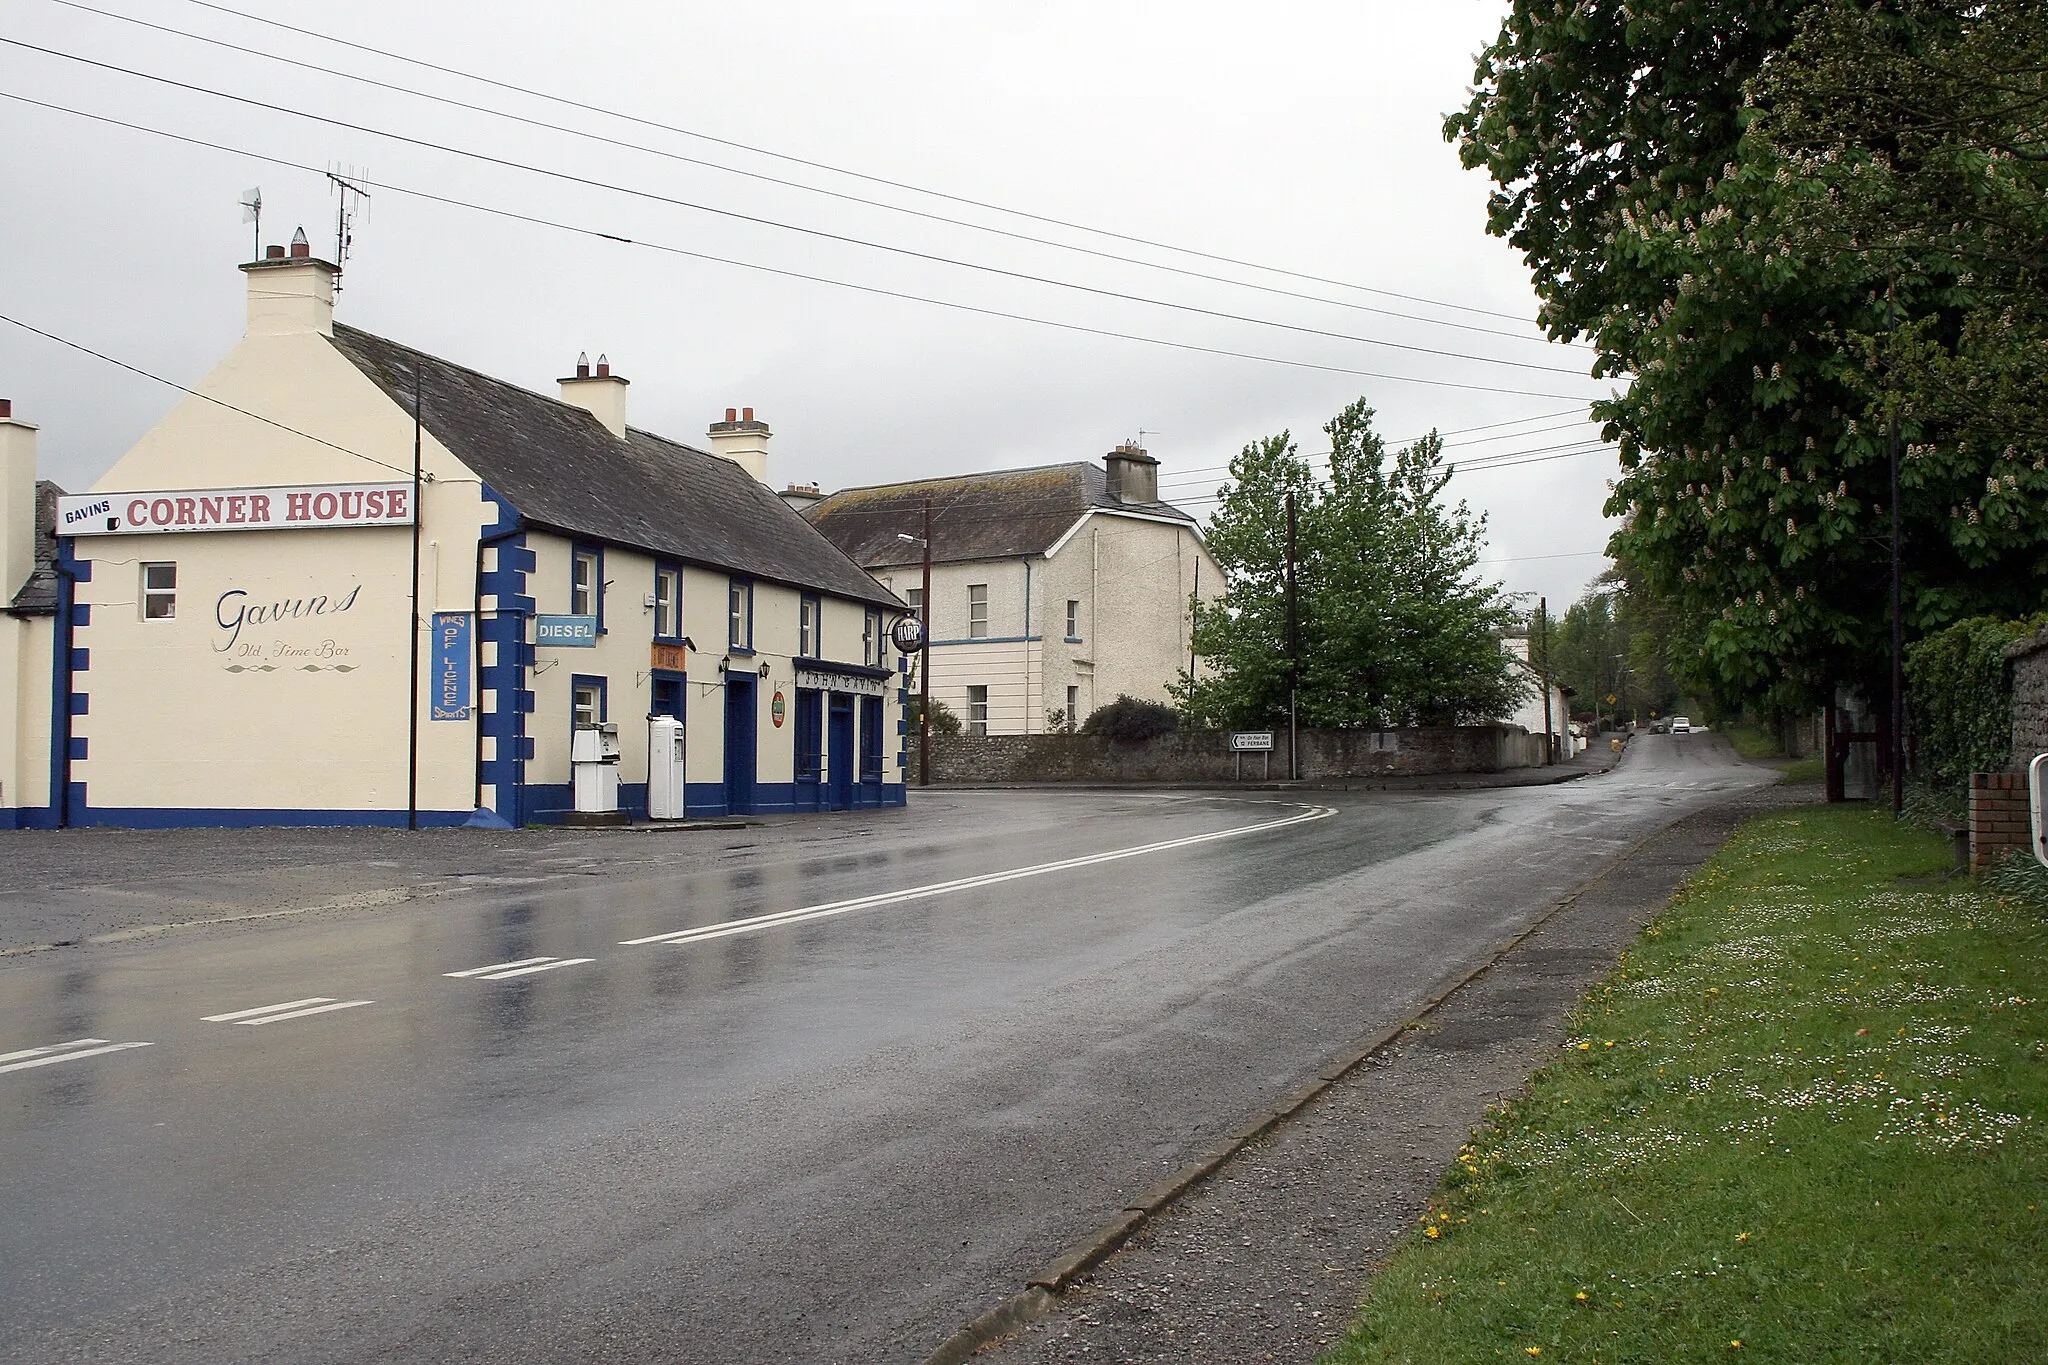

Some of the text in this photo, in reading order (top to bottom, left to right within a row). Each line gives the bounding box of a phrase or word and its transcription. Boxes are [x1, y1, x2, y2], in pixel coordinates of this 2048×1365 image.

[65, 500, 111, 524] GAVINS
[127, 490, 408, 526] CORNER HOUSE
[211, 585, 362, 652] Gavins
[440, 616, 464, 628] WINES
[539, 625, 593, 638] DIESEL
[897, 625, 919, 641] HARP
[238, 639, 349, 659] Old Time Bar
[444, 628, 458, 706] OFF LICENCE
[434, 706, 466, 718] SPIRITS
